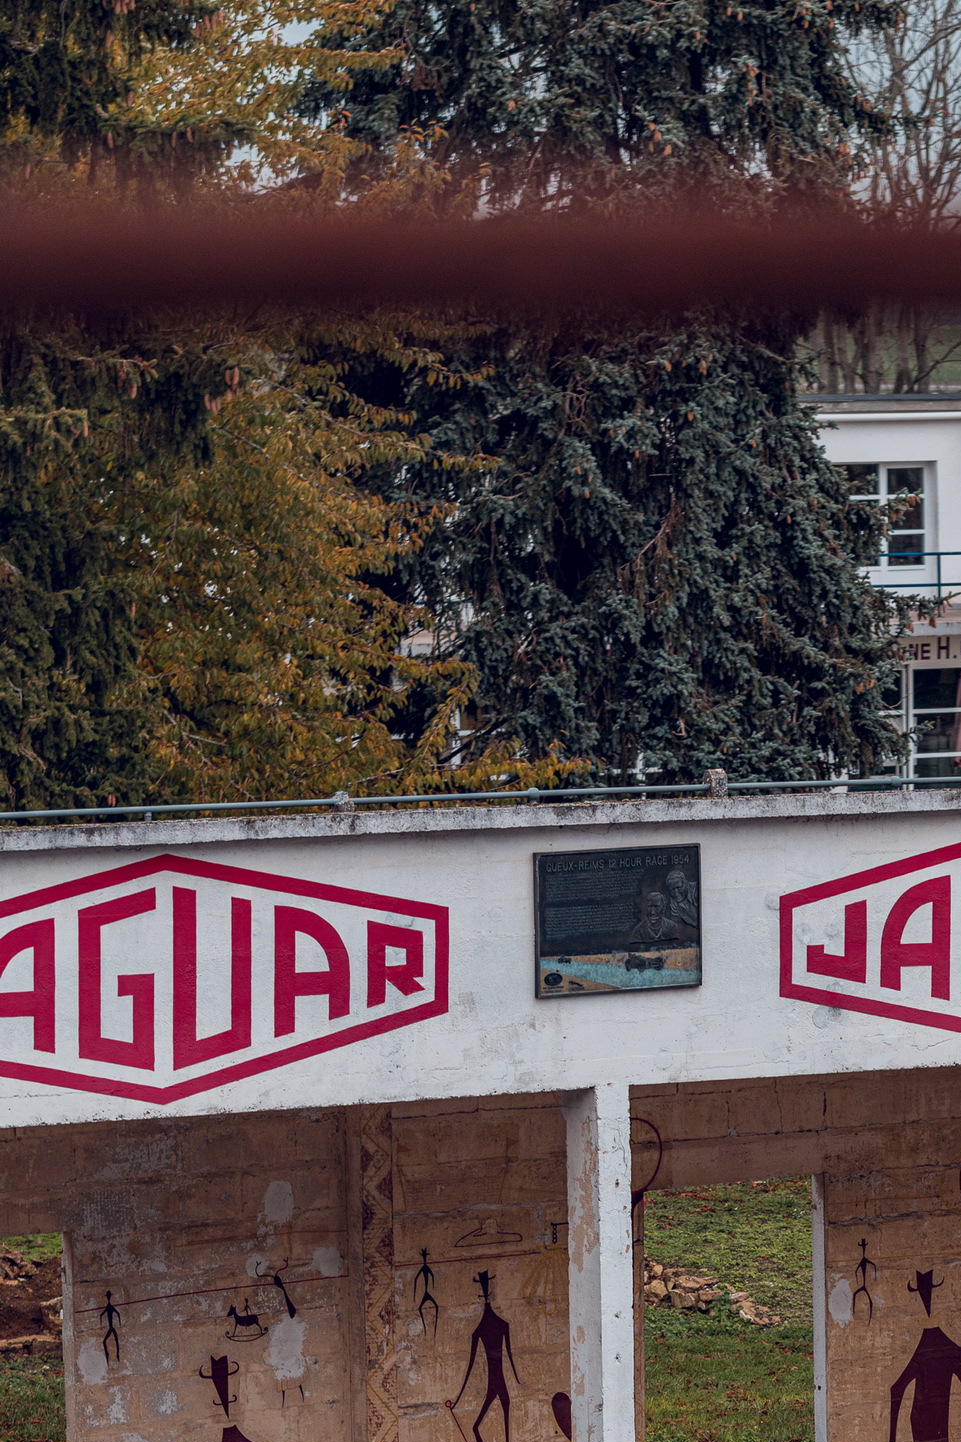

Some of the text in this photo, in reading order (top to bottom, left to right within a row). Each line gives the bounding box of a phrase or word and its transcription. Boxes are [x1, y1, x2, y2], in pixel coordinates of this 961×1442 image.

[608, 859, 616, 869] 12
[619, 857, 642, 868] HOUR
[645, 855, 668, 866] RACE
[671, 854, 690, 865] 1954
